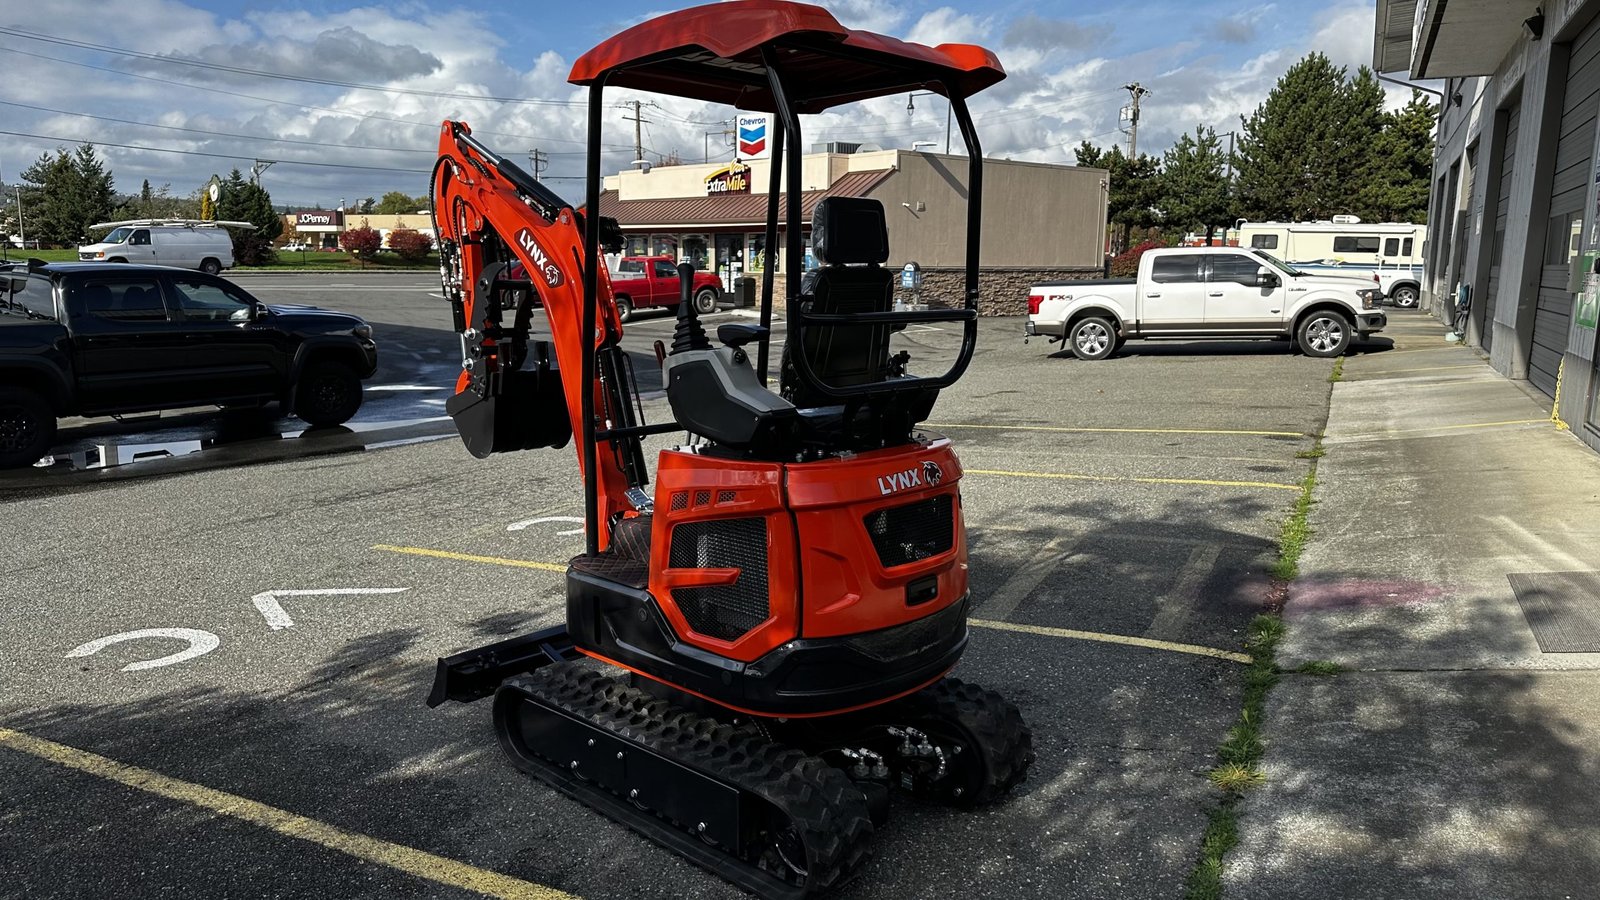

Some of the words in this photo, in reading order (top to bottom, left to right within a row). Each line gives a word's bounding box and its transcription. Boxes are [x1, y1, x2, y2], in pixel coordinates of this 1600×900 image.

[740, 117, 766, 126] Chevron
[706, 174, 746, 192] ExtraMile
[299, 213, 331, 225] JCPenney
[519, 229, 548, 271] LYNX
[878, 468, 921, 495] LYNX
